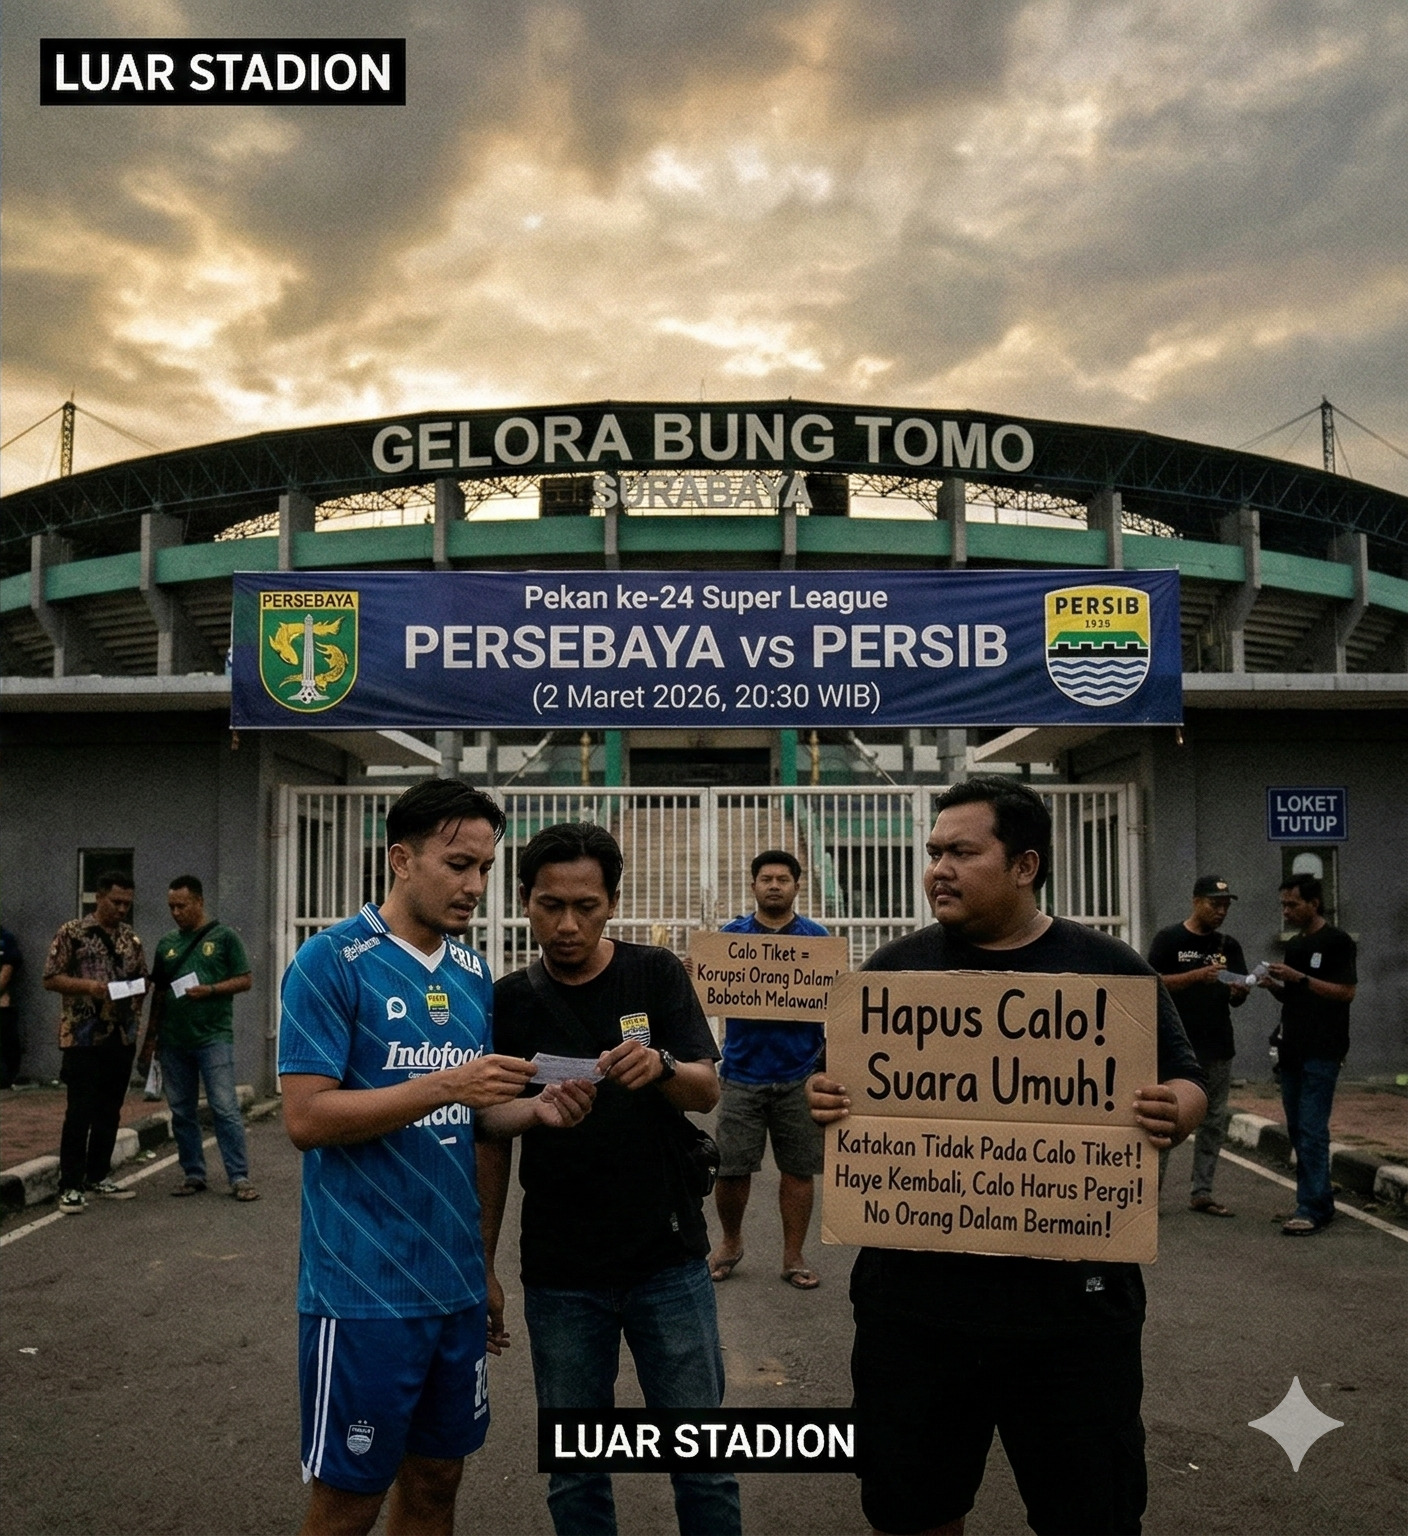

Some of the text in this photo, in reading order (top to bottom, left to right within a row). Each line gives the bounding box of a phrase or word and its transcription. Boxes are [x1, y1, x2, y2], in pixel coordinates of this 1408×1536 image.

[373, 413, 1033, 476] GELORA BUNG TOMO
[593, 474, 814, 509] SURABAYA
[263, 594, 354, 608] PERSEBAYA
[526, 585, 887, 614] Pekan ke-24 Super League
[1056, 597, 1138, 614] PERSIB
[406, 625, 725, 668] PERSEBAYA
[814, 625, 1007, 668] PERSIB
[534, 682, 880, 714] (2 Maret 2026, 20:30 WIB)
[1277, 796, 1337, 812] LOKET
[1277, 816, 1337, 832] TUTUP
[729, 942, 757, 959] Calo
[762, 944, 796, 961] Tiket
[698, 963, 745, 987] Korupsi
[750, 967, 789, 989] Orang
[708, 987, 827, 1010] Bobotoh Melawan!
[862, 986, 1106, 1051] Hapus Calo!
[867, 1052, 1116, 1111] Suara Umuh!
[838, 1129, 1141, 1169] Katakan Tidak Pada Calo Tiket!
[836, 1164, 1142, 1209] Haye Kembali, Calo Harus Pergi!
[865, 1201, 1111, 1238] No Orang Dalam Bermain!
